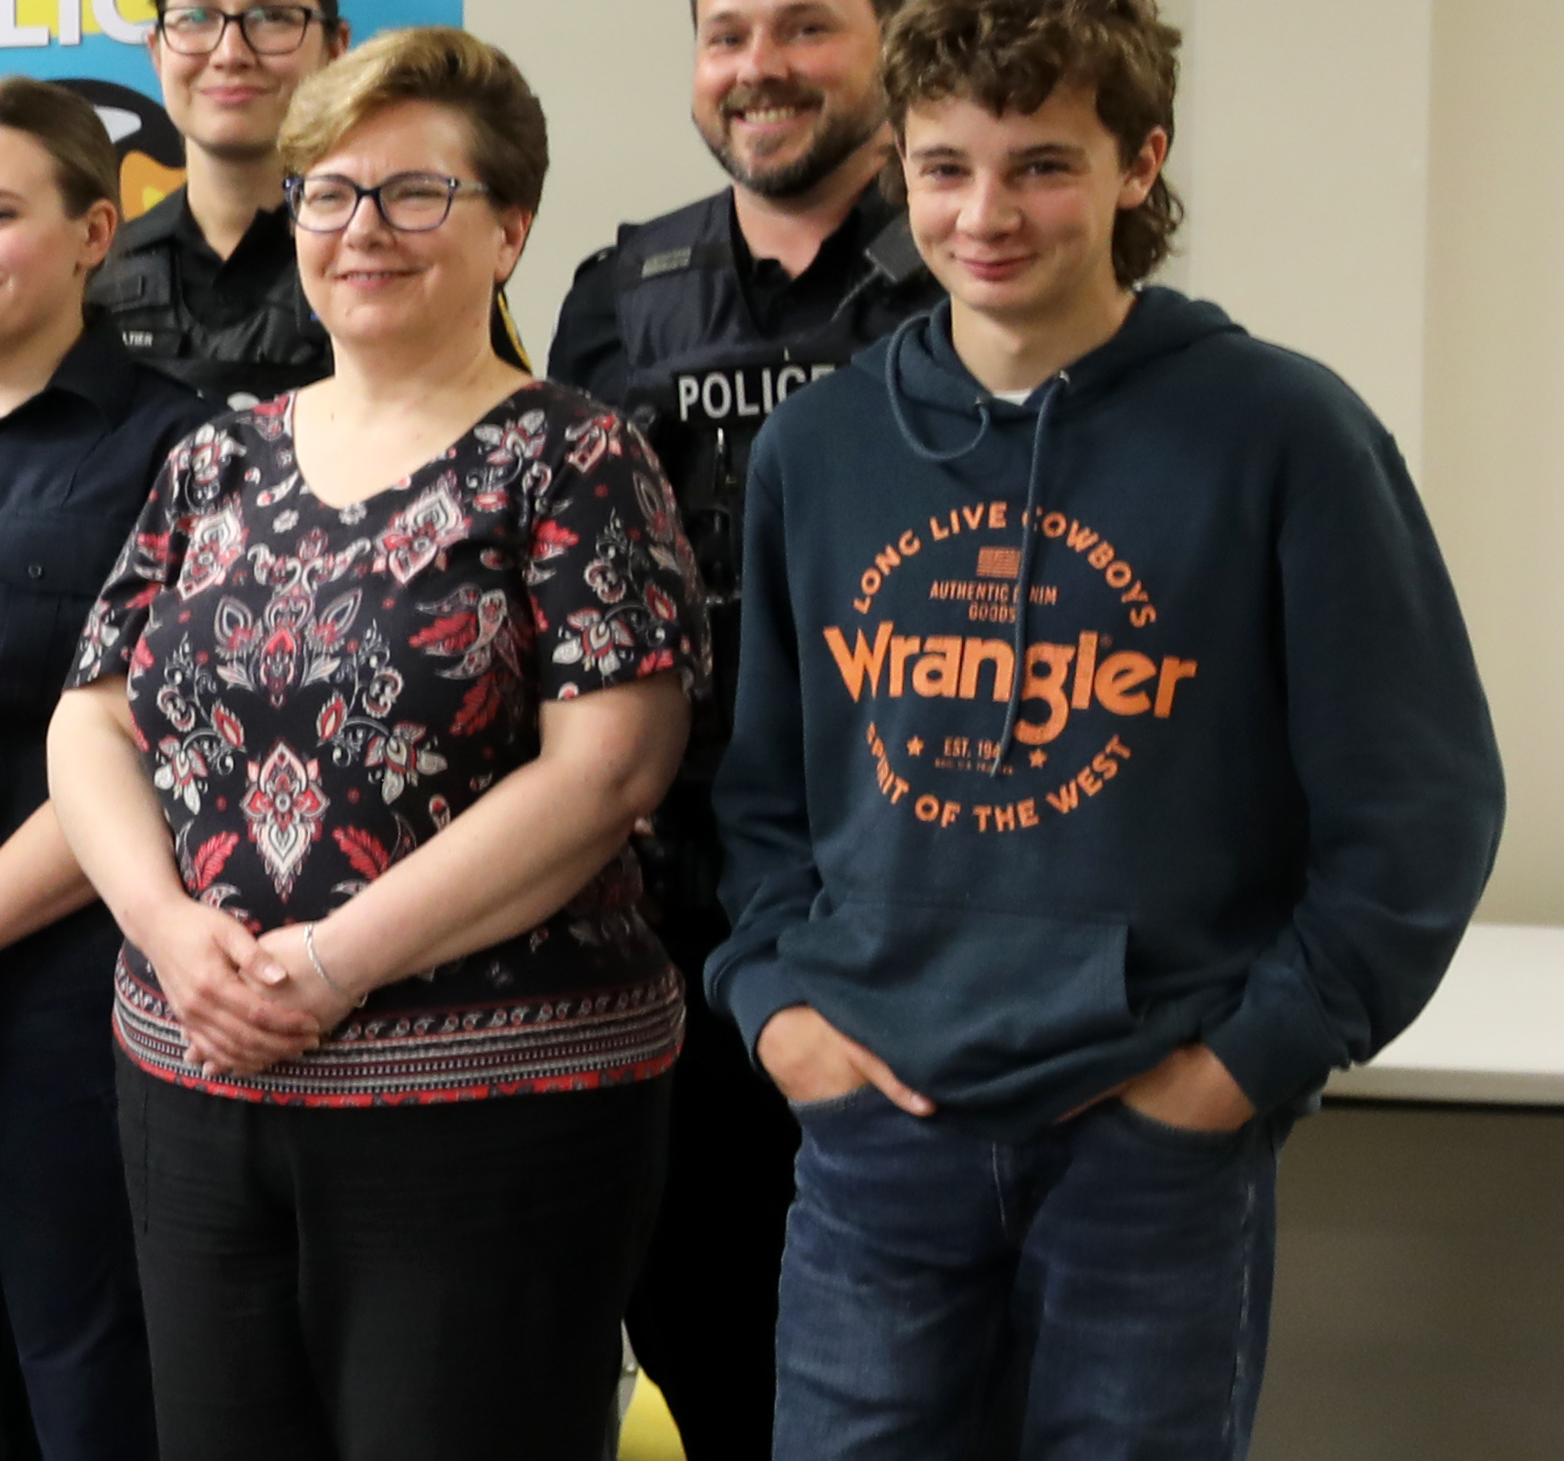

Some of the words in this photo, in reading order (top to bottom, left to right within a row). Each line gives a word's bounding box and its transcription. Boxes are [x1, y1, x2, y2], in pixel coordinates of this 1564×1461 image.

[853, 528, 923, 615] LONG
[929, 501, 1008, 541] LIVE
[928, 580, 1010, 604] AUTHENTIC
[968, 603, 1017, 624] GOODS
[822, 620, 1198, 746] Wrangler
[914, 793, 962, 829] OF
[972, 796, 1040, 833] THE
[1045, 734, 1132, 815] WEST
